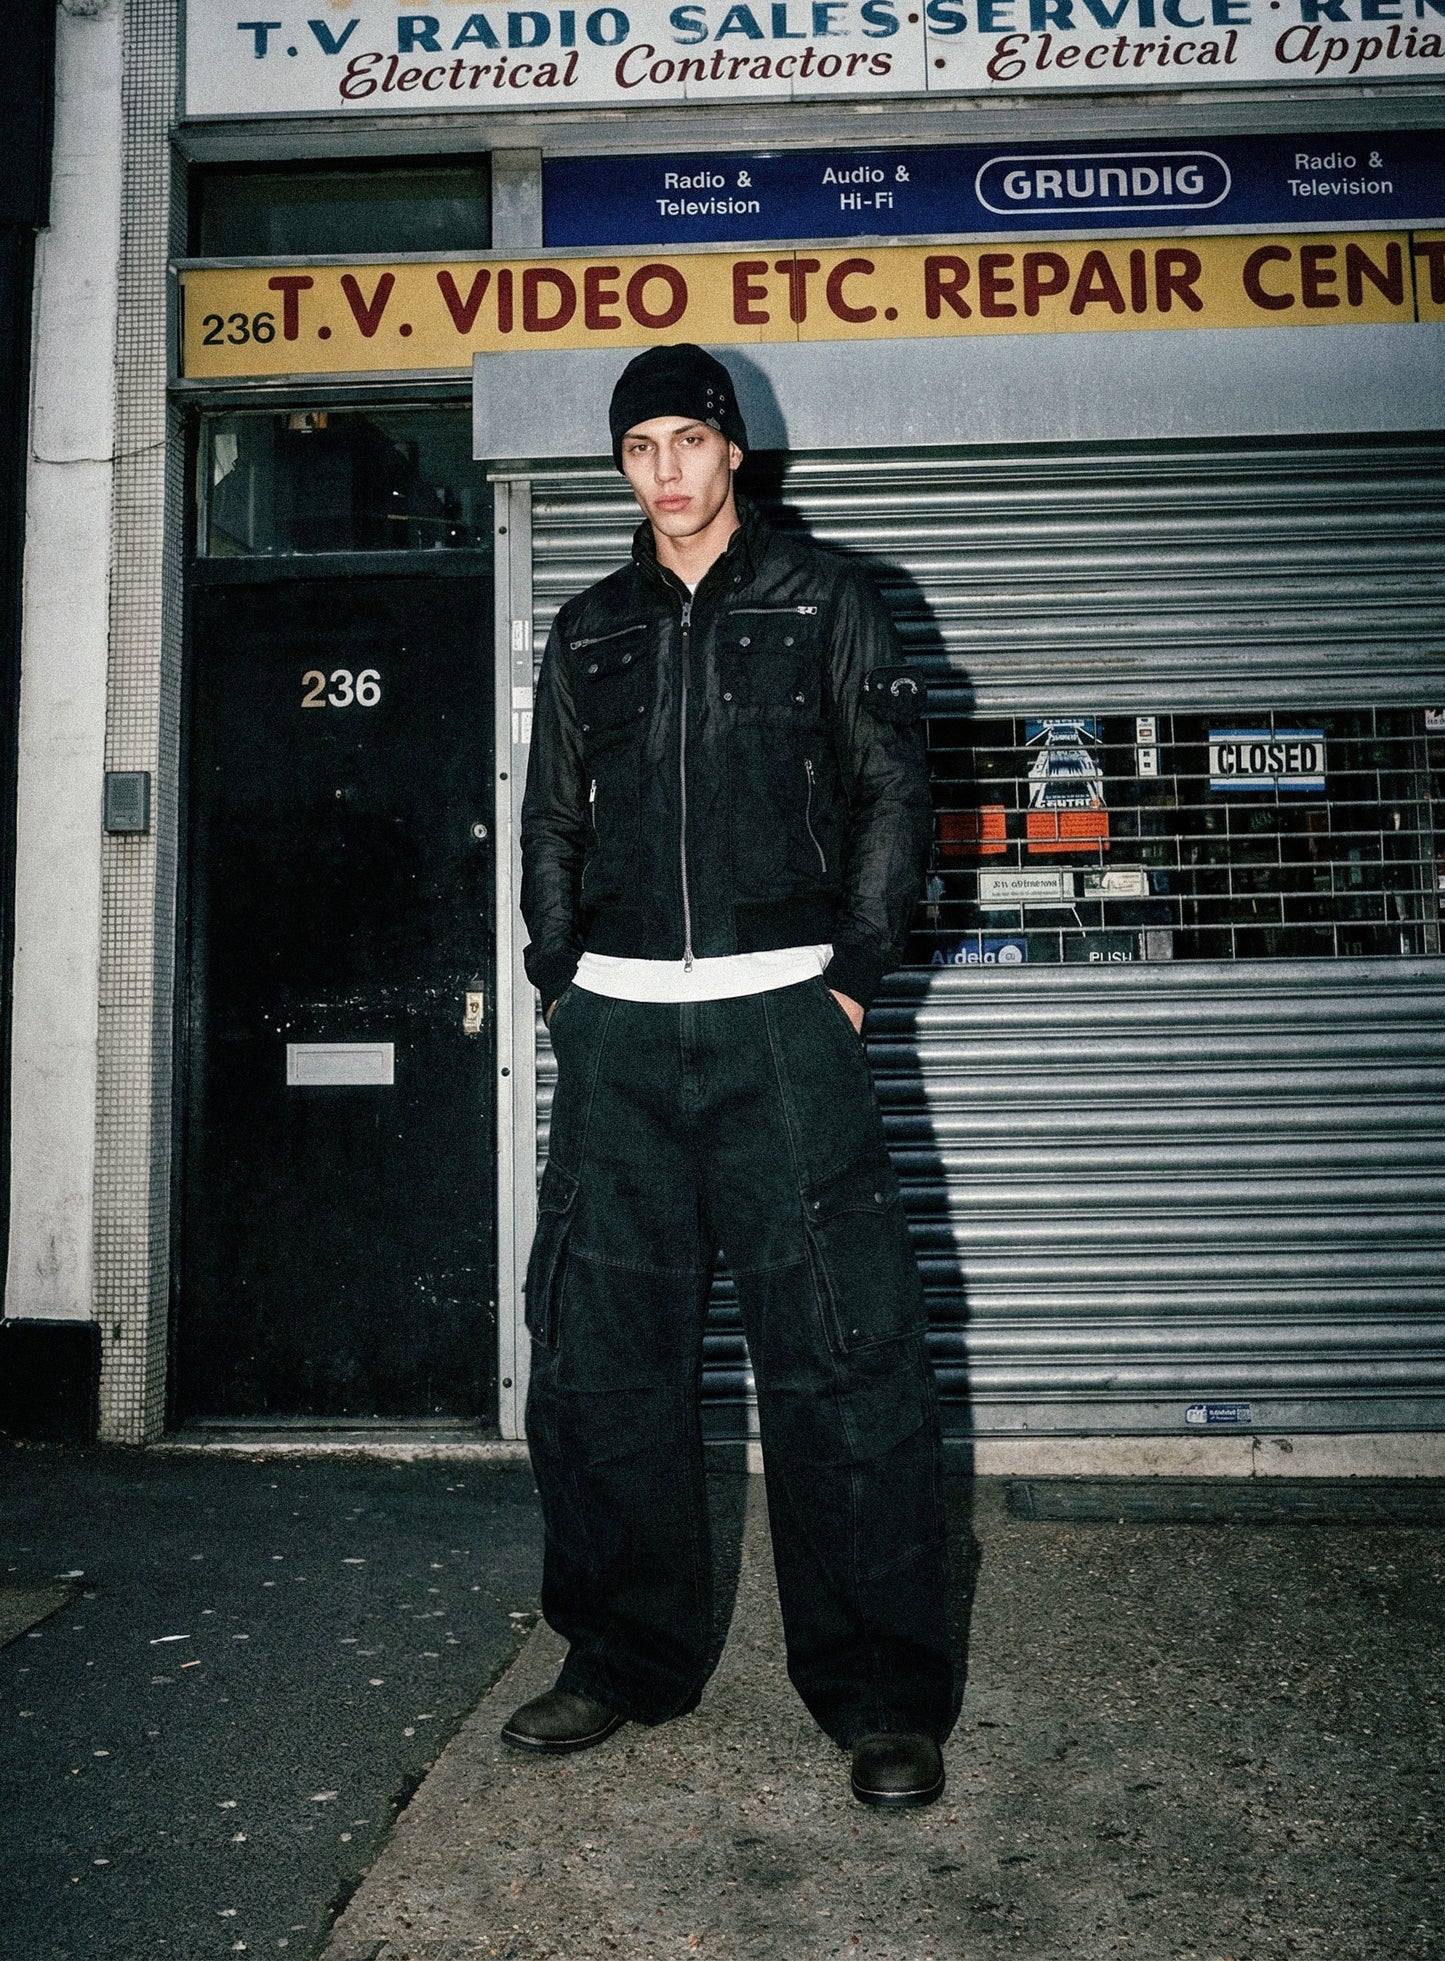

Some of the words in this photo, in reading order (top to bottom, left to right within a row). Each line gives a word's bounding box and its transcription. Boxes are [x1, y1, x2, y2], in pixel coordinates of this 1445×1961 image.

[237, 19, 361, 58] T.V
[397, 8, 630, 53] RADIO
[669, 0, 900, 45] SALES
[926, 0, 1252, 34] SERVICE
[340, 50, 579, 101] Electrical
[616, 44, 893, 88] Contractors
[986, 29, 1238, 82] Electrical
[1295, 152, 1357, 170] Radio
[1368, 151, 1383, 168] &
[664, 171, 726, 189] Radio
[737, 171, 753, 188] &
[822, 166, 885, 185] Audio
[895, 165, 910, 182] &
[1003, 165, 1204, 200] GRUNDIG
[1287, 177, 1393, 196] Television
[656, 197, 760, 216] Television
[839, 192, 894, 210] Hi-Fi
[268, 272, 413, 341] T.V.
[437, 263, 689, 335] VIDEO
[733, 258, 899, 325] ETC.
[925, 248, 1204, 320] REPAIR
[1243, 242, 1445, 310] CENT
[202, 312, 276, 346] 236
[301, 669, 381, 708] 236
[1218, 743, 1316, 775] CLOSED
[1089, 951, 1132, 962] PUSH
